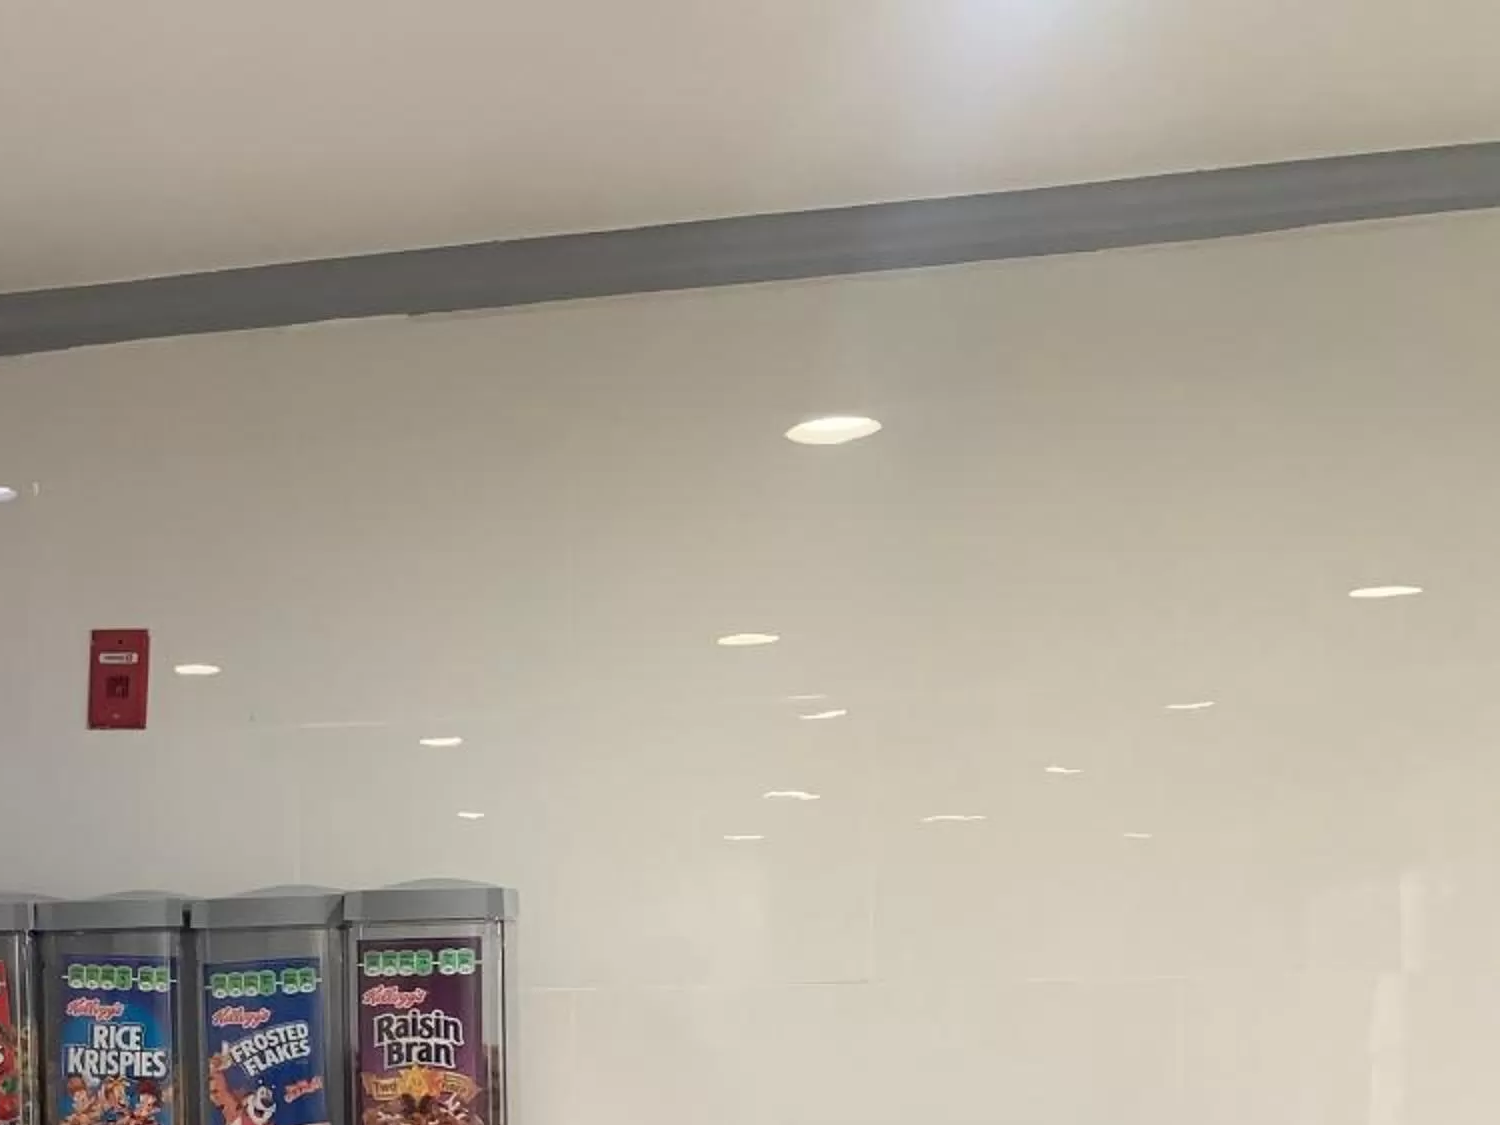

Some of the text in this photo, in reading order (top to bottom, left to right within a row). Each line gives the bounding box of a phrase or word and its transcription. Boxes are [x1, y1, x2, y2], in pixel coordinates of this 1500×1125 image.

[93, 1025, 143, 1050] RICE
[230, 1022, 309, 1062] FROSTED
[374, 1009, 464, 1046] Raisin
[67, 1048, 167, 1078] KRISPIES
[243, 1040, 311, 1076] FLAKES
[385, 1041, 454, 1069] Bran
